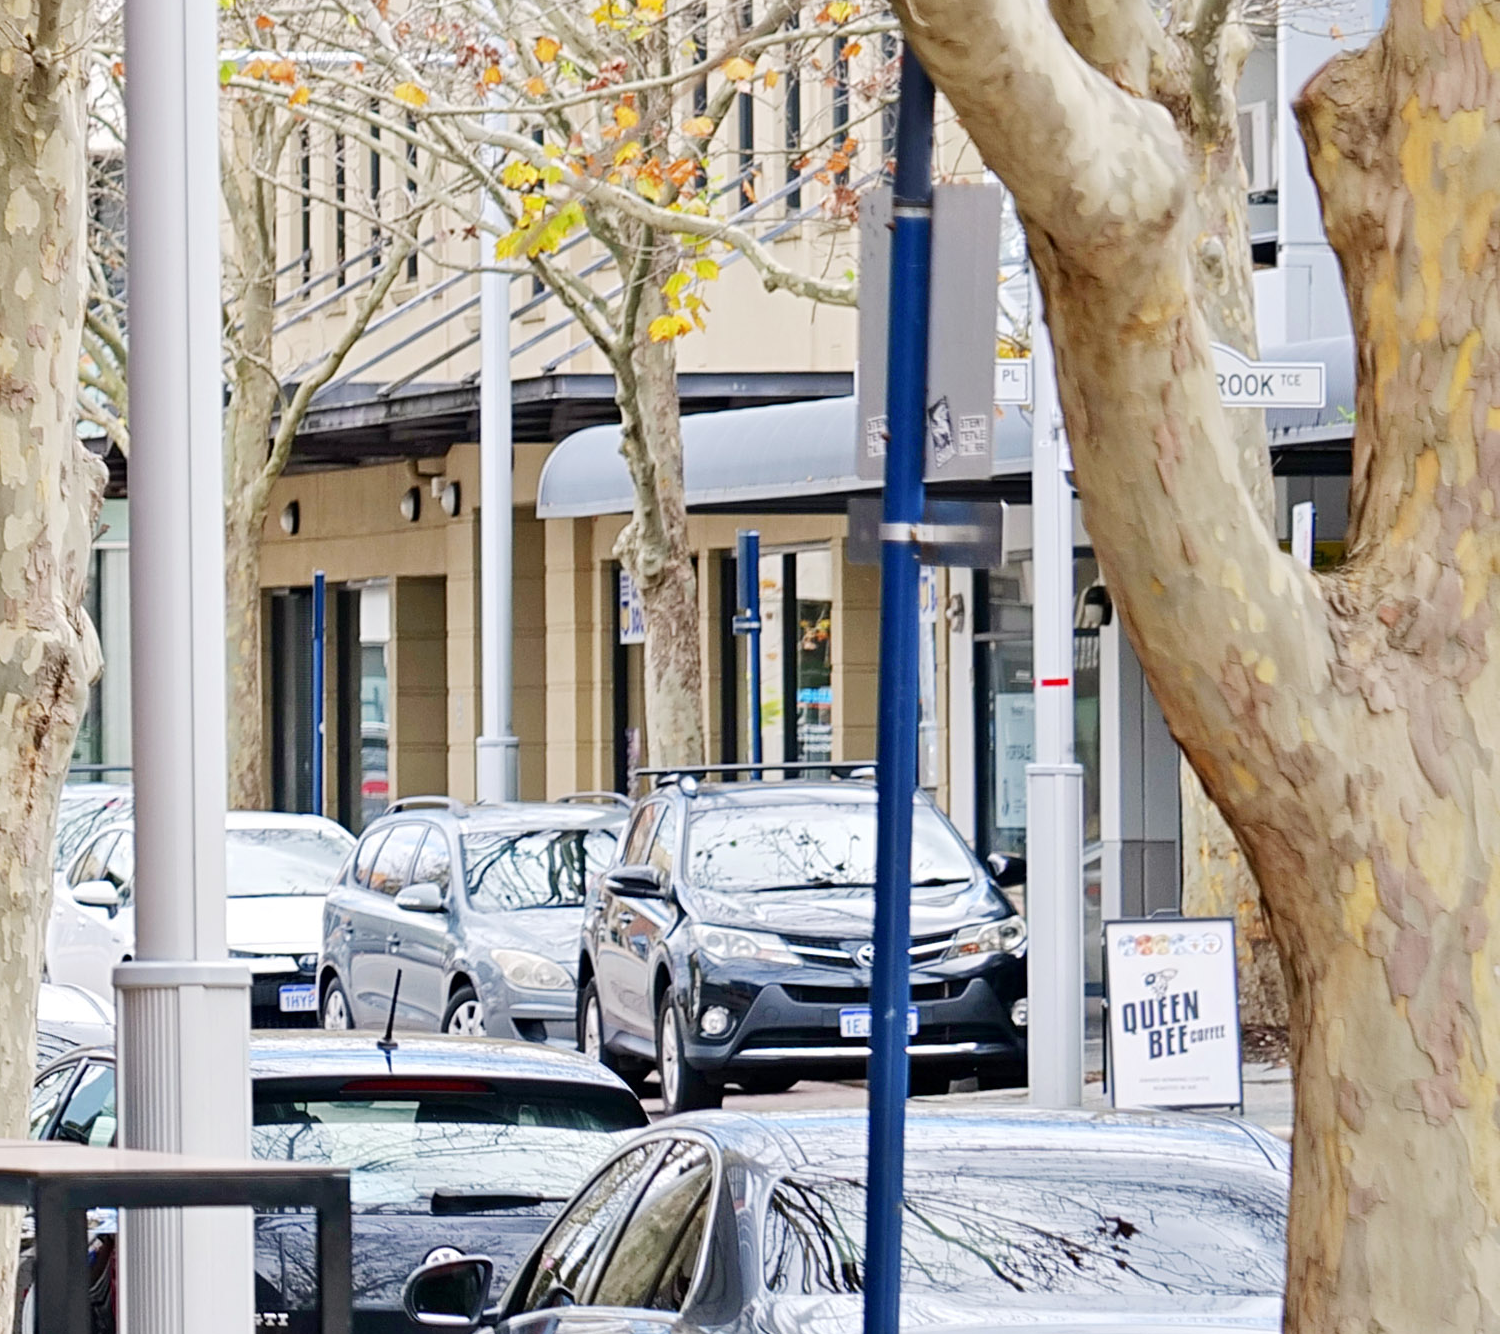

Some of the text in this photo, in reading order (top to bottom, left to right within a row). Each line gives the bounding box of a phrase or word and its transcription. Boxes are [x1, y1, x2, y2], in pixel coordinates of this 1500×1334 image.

[1002, 370, 1019, 383] PL
[1216, 374, 1301, 396] ROOK TCE
[1122, 990, 1199, 1034] QUEEN
[1149, 1025, 1226, 1060] BEE COFFEE
